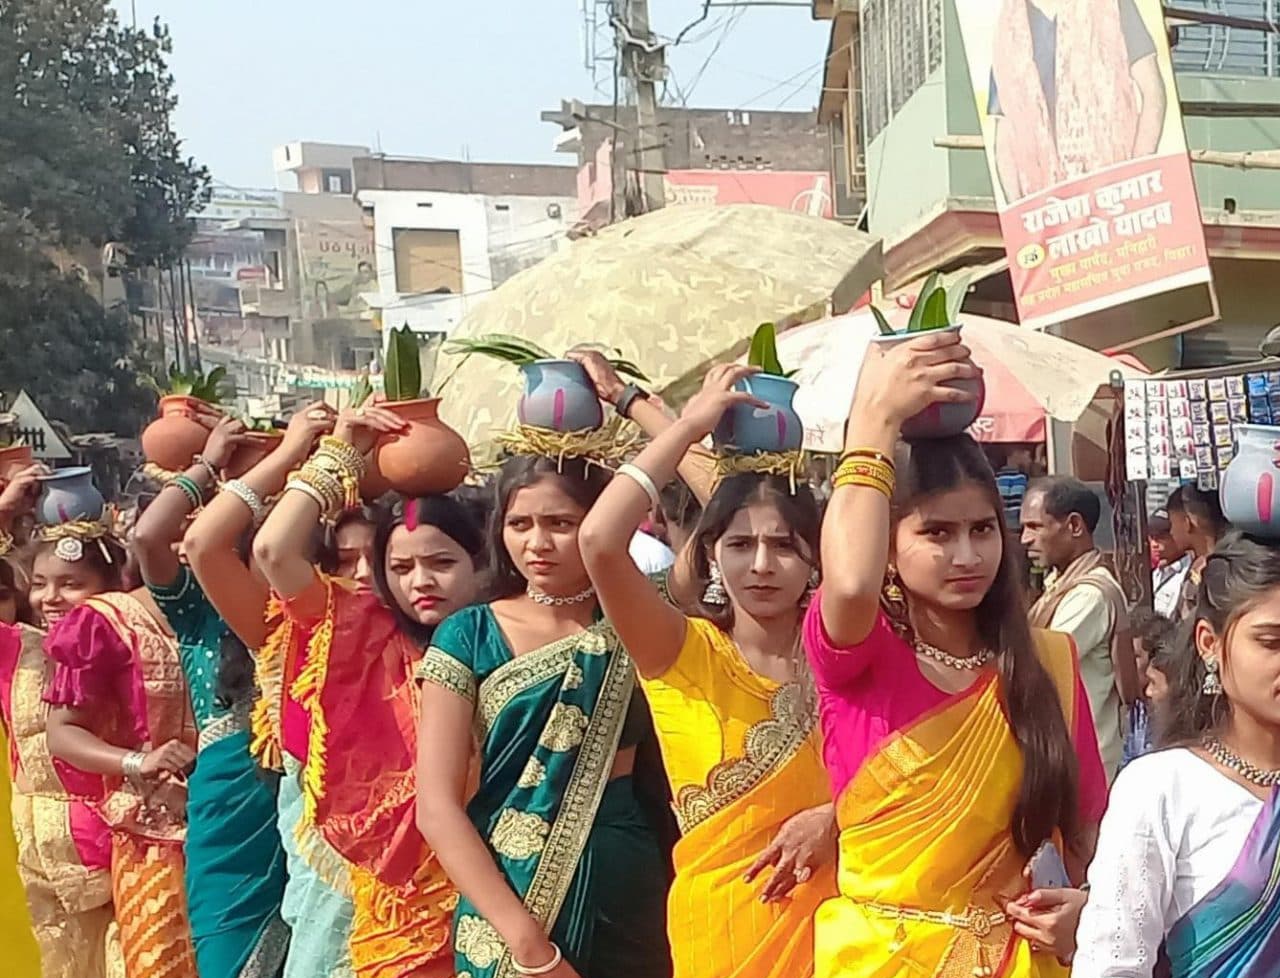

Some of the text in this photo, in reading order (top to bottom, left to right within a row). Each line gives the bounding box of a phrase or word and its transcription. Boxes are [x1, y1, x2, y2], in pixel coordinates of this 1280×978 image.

[1022, 170, 1164, 232] राजेश कुमार
[1114, 202, 1173, 236] यादव
